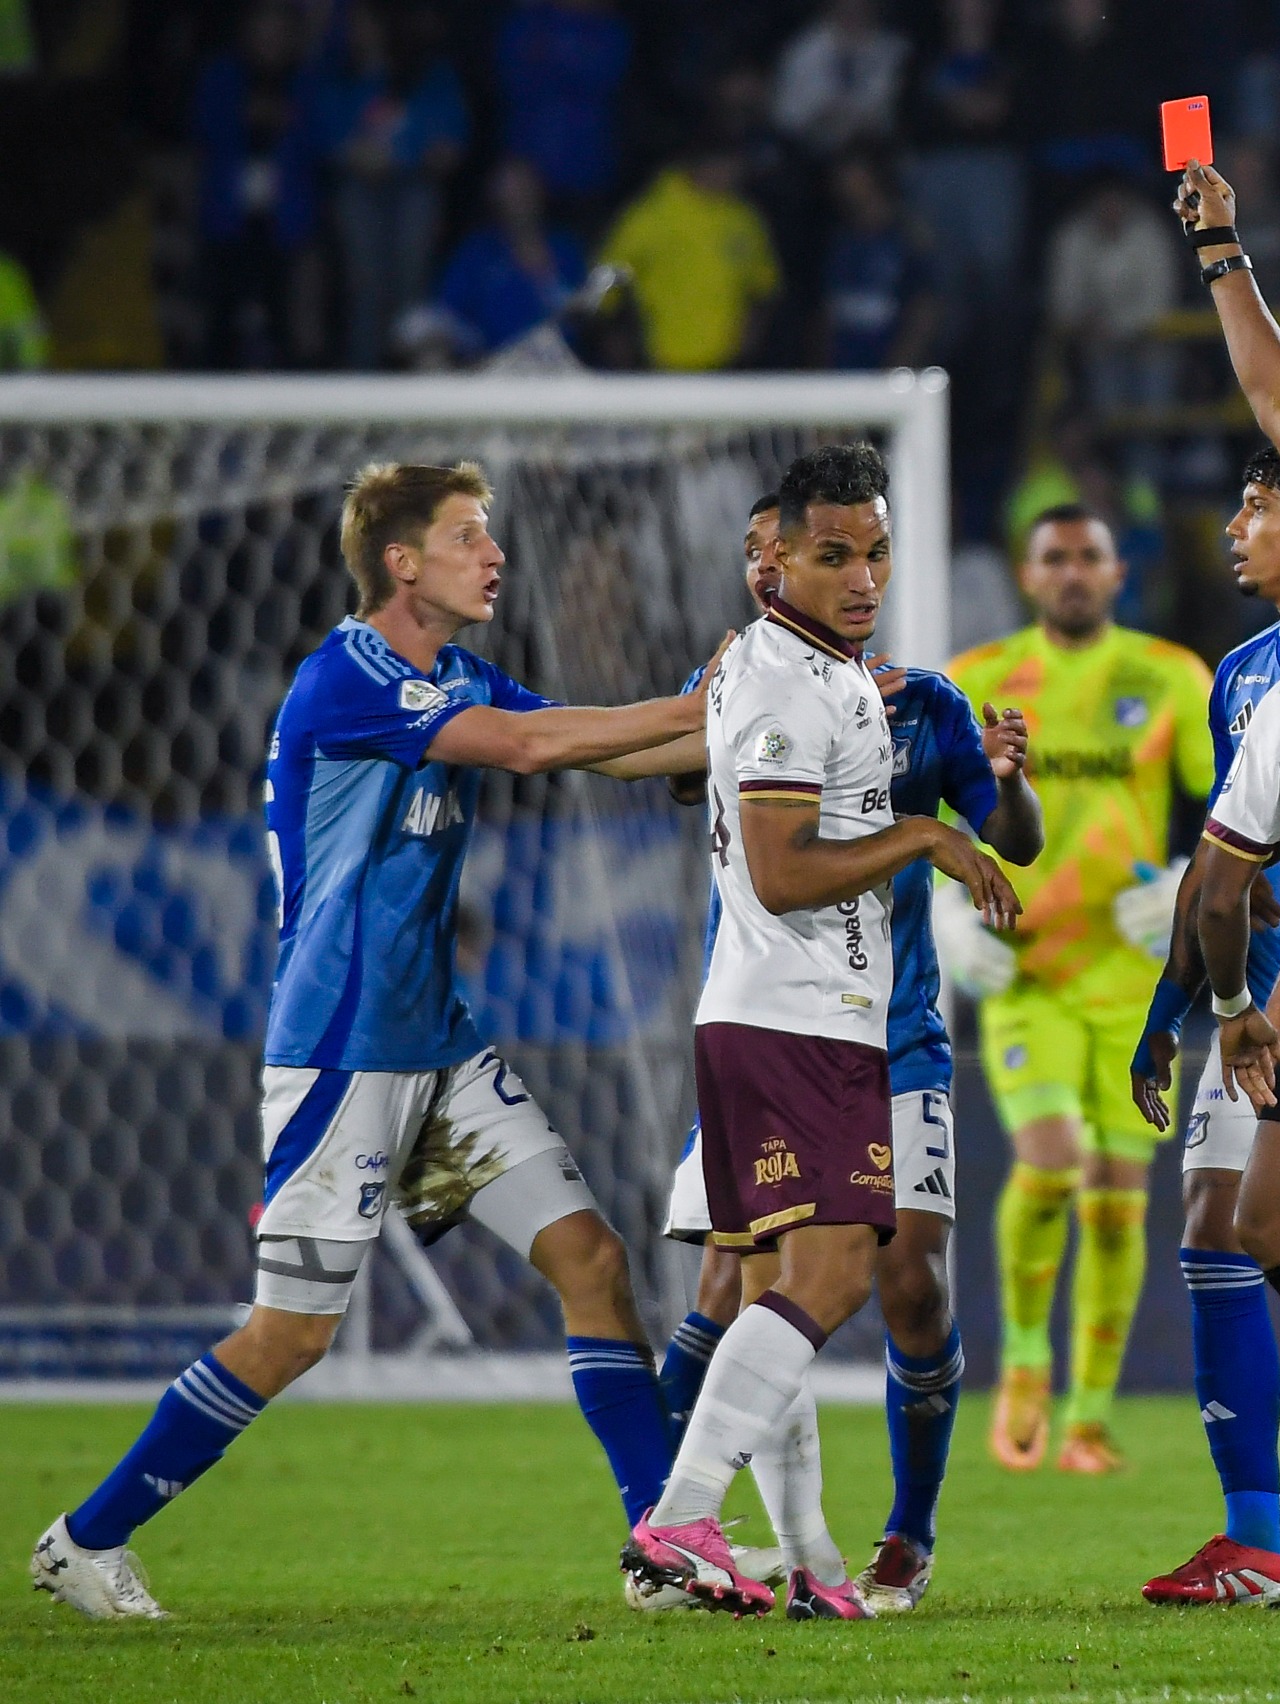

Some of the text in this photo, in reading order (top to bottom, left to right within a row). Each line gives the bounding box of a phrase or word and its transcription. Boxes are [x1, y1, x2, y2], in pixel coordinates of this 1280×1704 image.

[922, 1093, 949, 1159] 5
[761, 1139, 787, 1153] TAPA
[754, 1152, 801, 1185] ROJA
